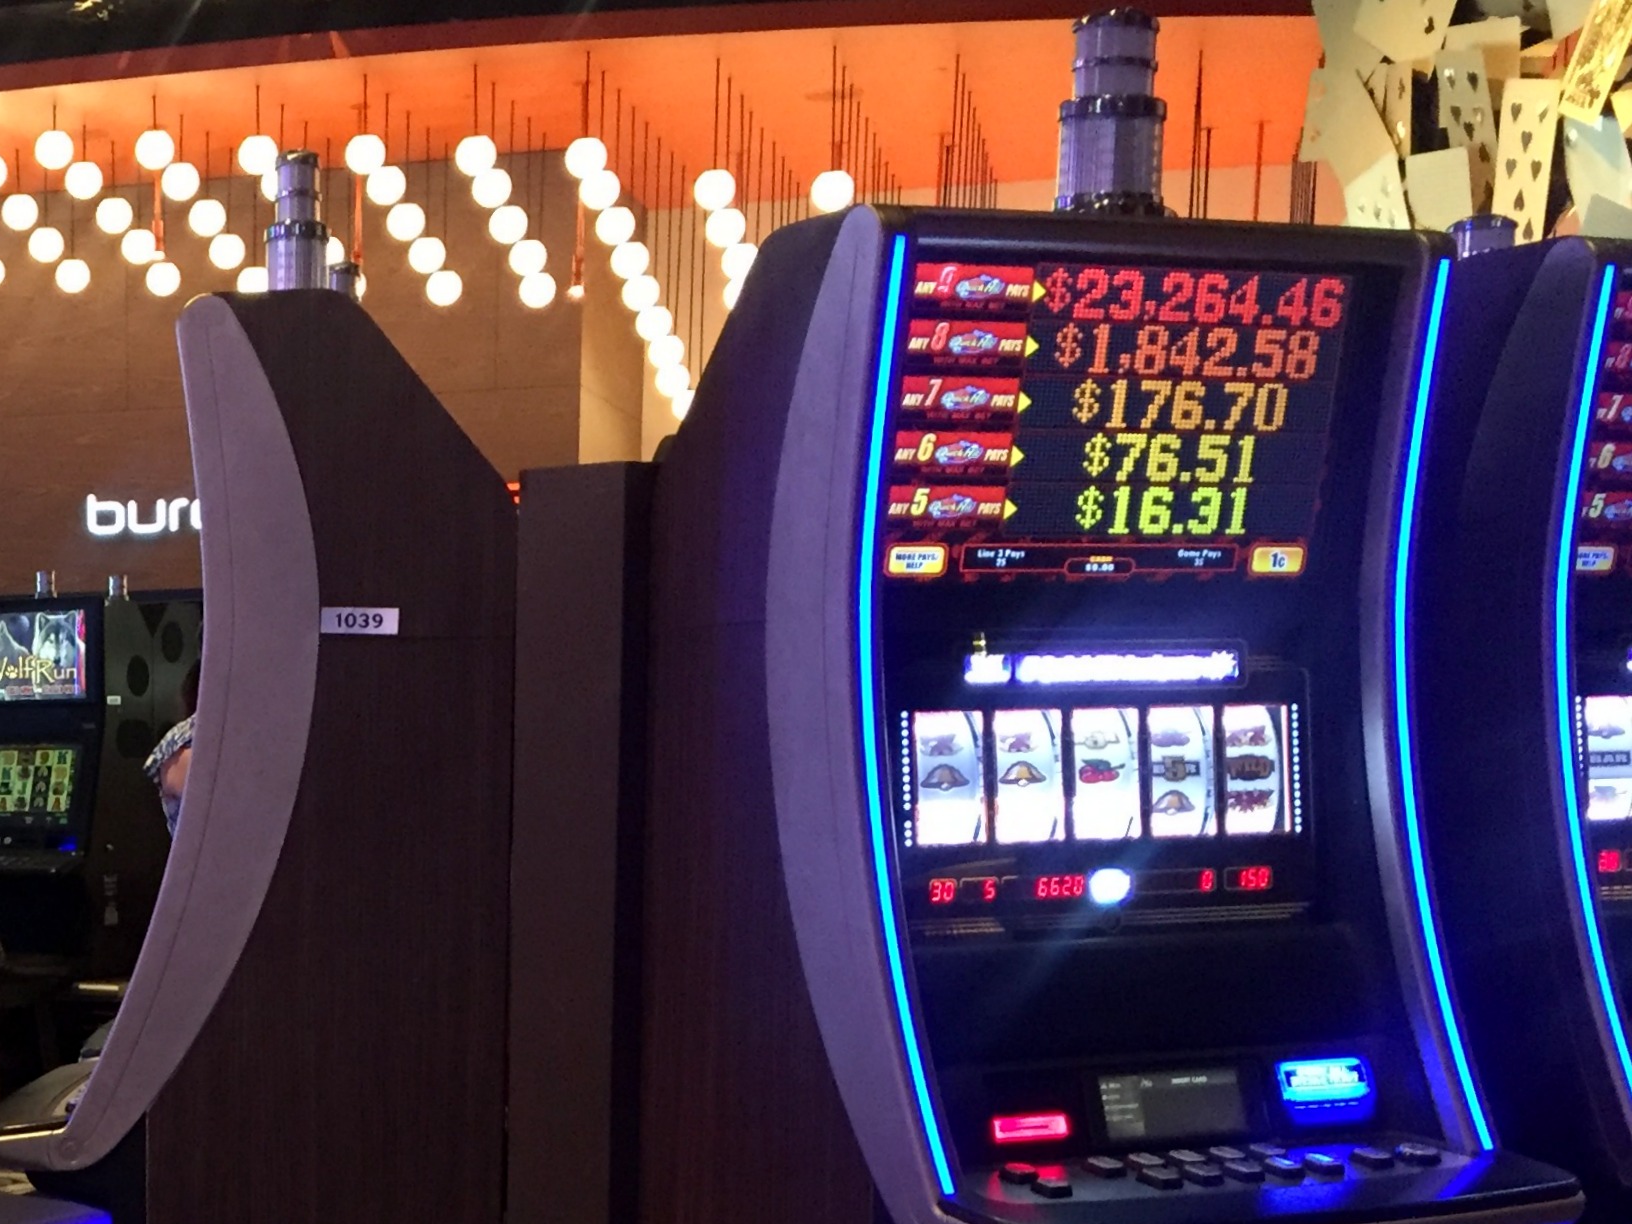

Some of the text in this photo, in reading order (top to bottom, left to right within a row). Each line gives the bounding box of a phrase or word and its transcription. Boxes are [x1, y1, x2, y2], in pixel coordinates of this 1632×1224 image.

[915, 281, 937, 294] ANY
[1006, 283, 1031, 297] PAYS
[1044, 268, 1346, 328] $23,264.46
[908, 337, 930, 350] ANY
[931, 322, 950, 350] 8
[998, 339, 1023, 352] PAYS
[1054, 323, 1320, 379] $1,842.58
[902, 393, 924, 406] ANY
[925, 379, 943, 406] 7
[990, 395, 1015, 407] PAYS
[1072, 378, 1288, 431] $176.70
[1607, 394, 1625, 420] 7
[894, 448, 917, 461] ANY
[917, 433, 937, 462] 6
[984, 449, 1009, 461] PAYS
[1082, 432, 1255, 483] $76.51
[1597, 443, 1616, 469] 6
[888, 503, 910, 515] ANY
[910, 488, 930, 516] 5
[977, 503, 1002, 515] PAYS
[1075, 485, 1247, 534] $16.31
[1589, 493, 1607, 518] 5
[895, 553, 916, 561] MORE
[978, 549, 996, 558] Line
[1005, 549, 1025, 559] Pays
[1177, 549, 1221, 559] Game Pays
[335, 612, 384, 629] 1039
[36, 659, 77, 684] Run
[1589, 752, 1628, 764] BAR
[1201, 869, 1214, 890] 0
[1241, 867, 1270, 887] 150
[932, 881, 955, 901] 30
[984, 879, 996, 900] 5
